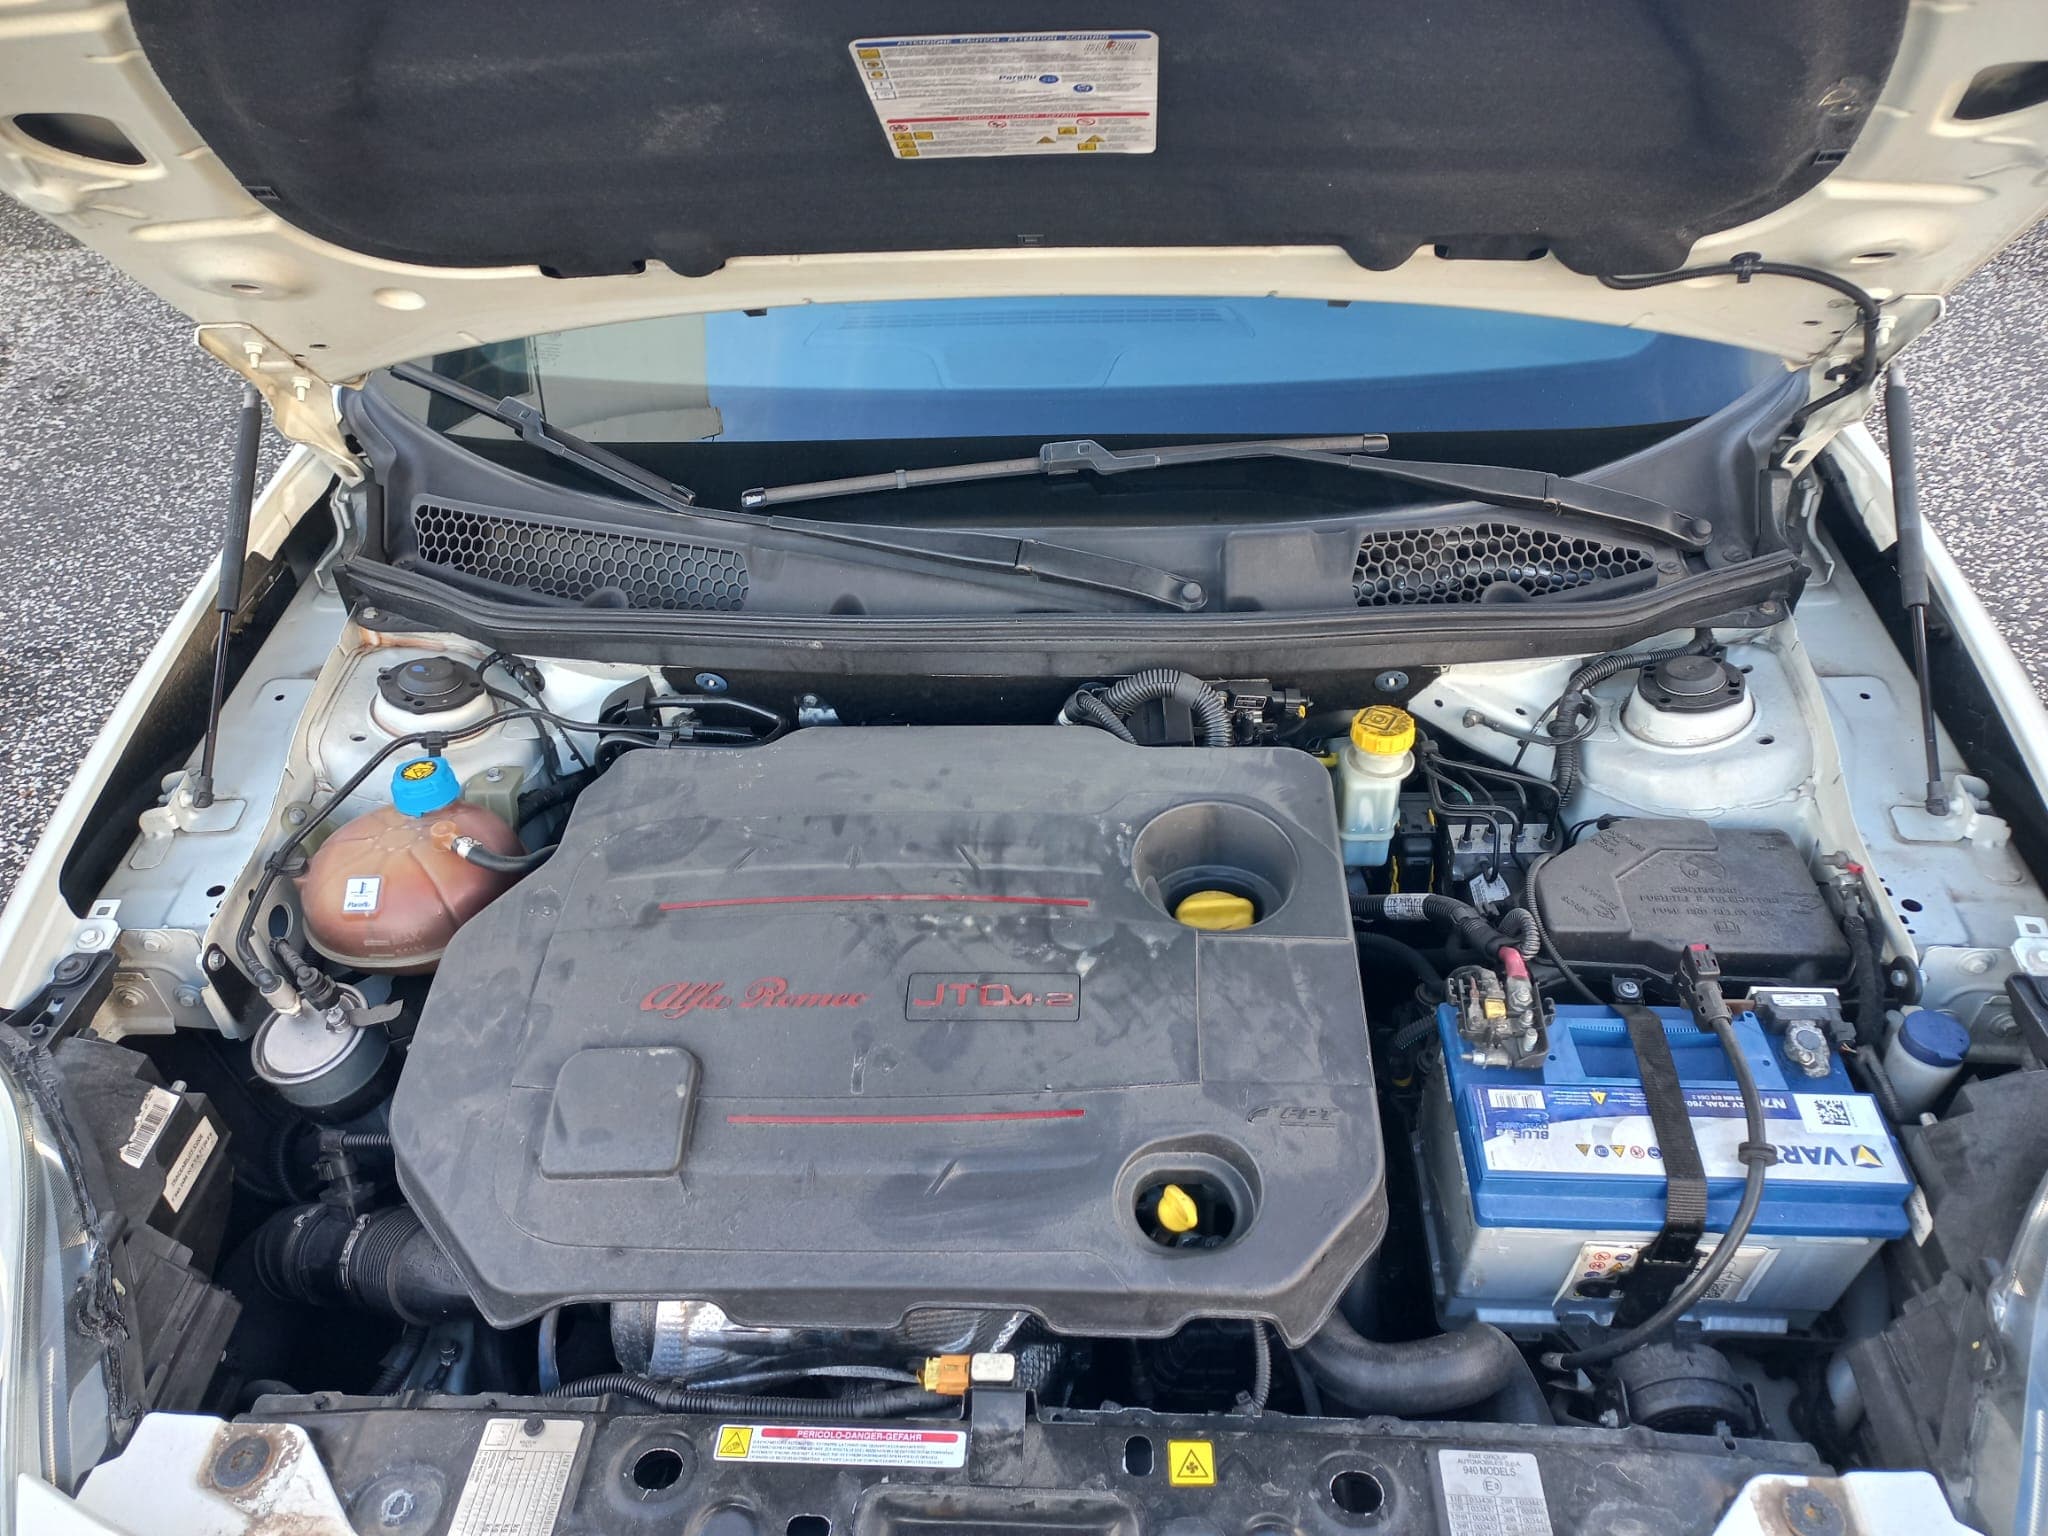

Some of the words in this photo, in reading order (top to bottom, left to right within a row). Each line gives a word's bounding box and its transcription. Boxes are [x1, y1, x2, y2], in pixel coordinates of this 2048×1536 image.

[640, 980, 732, 1020] Alfa
[738, 976, 870, 1009] Romeo
[1514, 1129, 1549, 1139] BLUE
[1462, 1466, 1478, 1475] 940
[1480, 1466, 1517, 1477] MODELS
